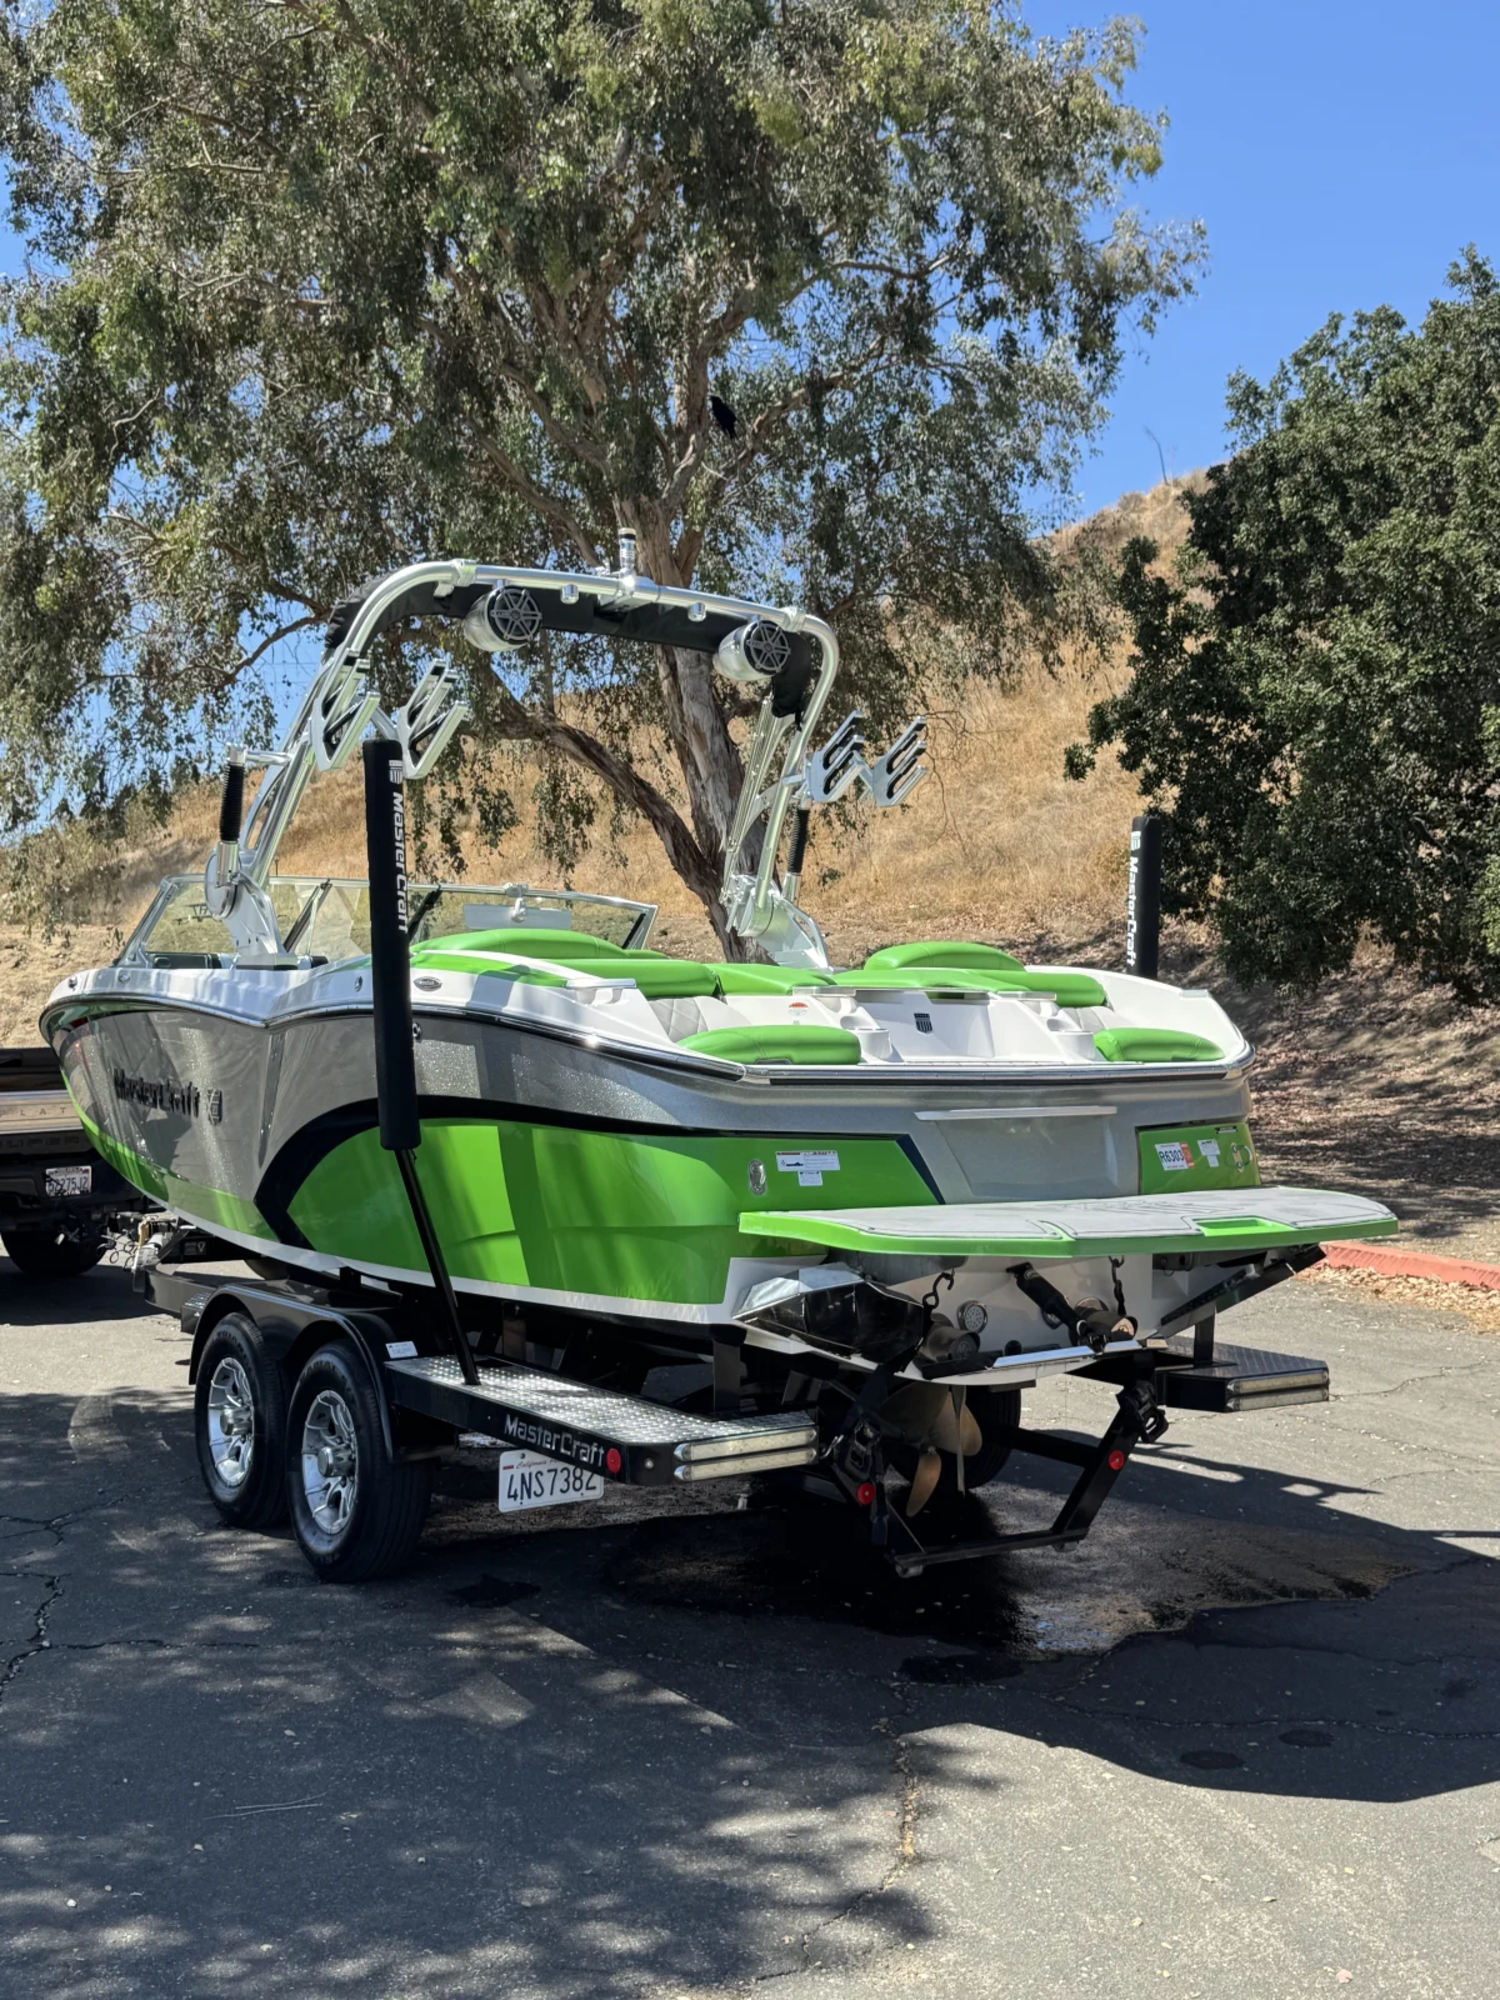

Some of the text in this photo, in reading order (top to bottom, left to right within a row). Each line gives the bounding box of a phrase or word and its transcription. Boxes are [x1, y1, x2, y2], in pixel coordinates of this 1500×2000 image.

[393, 791, 408, 934] MasterCraft
[1127, 856, 1139, 966] MasterCraft
[114, 1068, 200, 1118] MasterCraft
[504, 1413, 605, 1467] MasterCraft
[507, 1466, 597, 1501] 4NS7382
